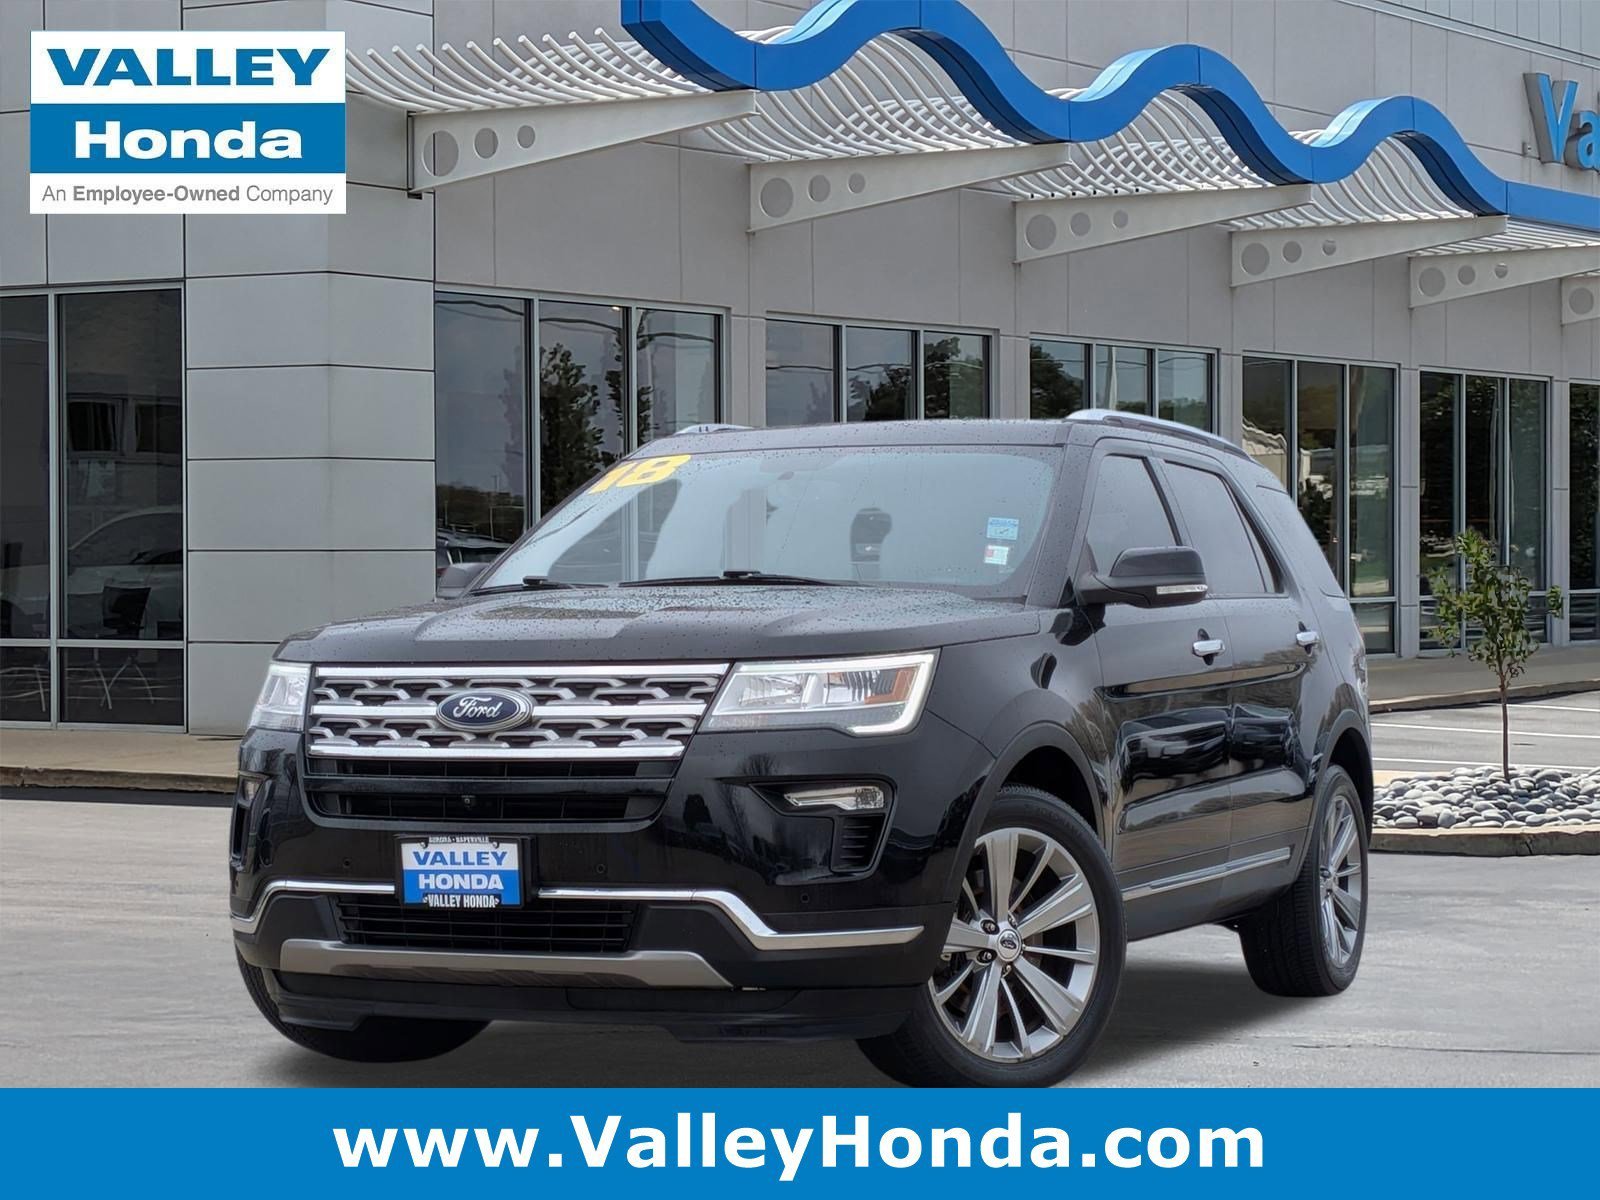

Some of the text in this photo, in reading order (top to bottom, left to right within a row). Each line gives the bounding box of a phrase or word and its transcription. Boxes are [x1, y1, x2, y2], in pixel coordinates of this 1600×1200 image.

[453, 696, 503, 718] Ford
[412, 851, 508, 866] VALLEY
[418, 873, 504, 890] HONDA
[427, 894, 496, 908] VALLEY HONDA
